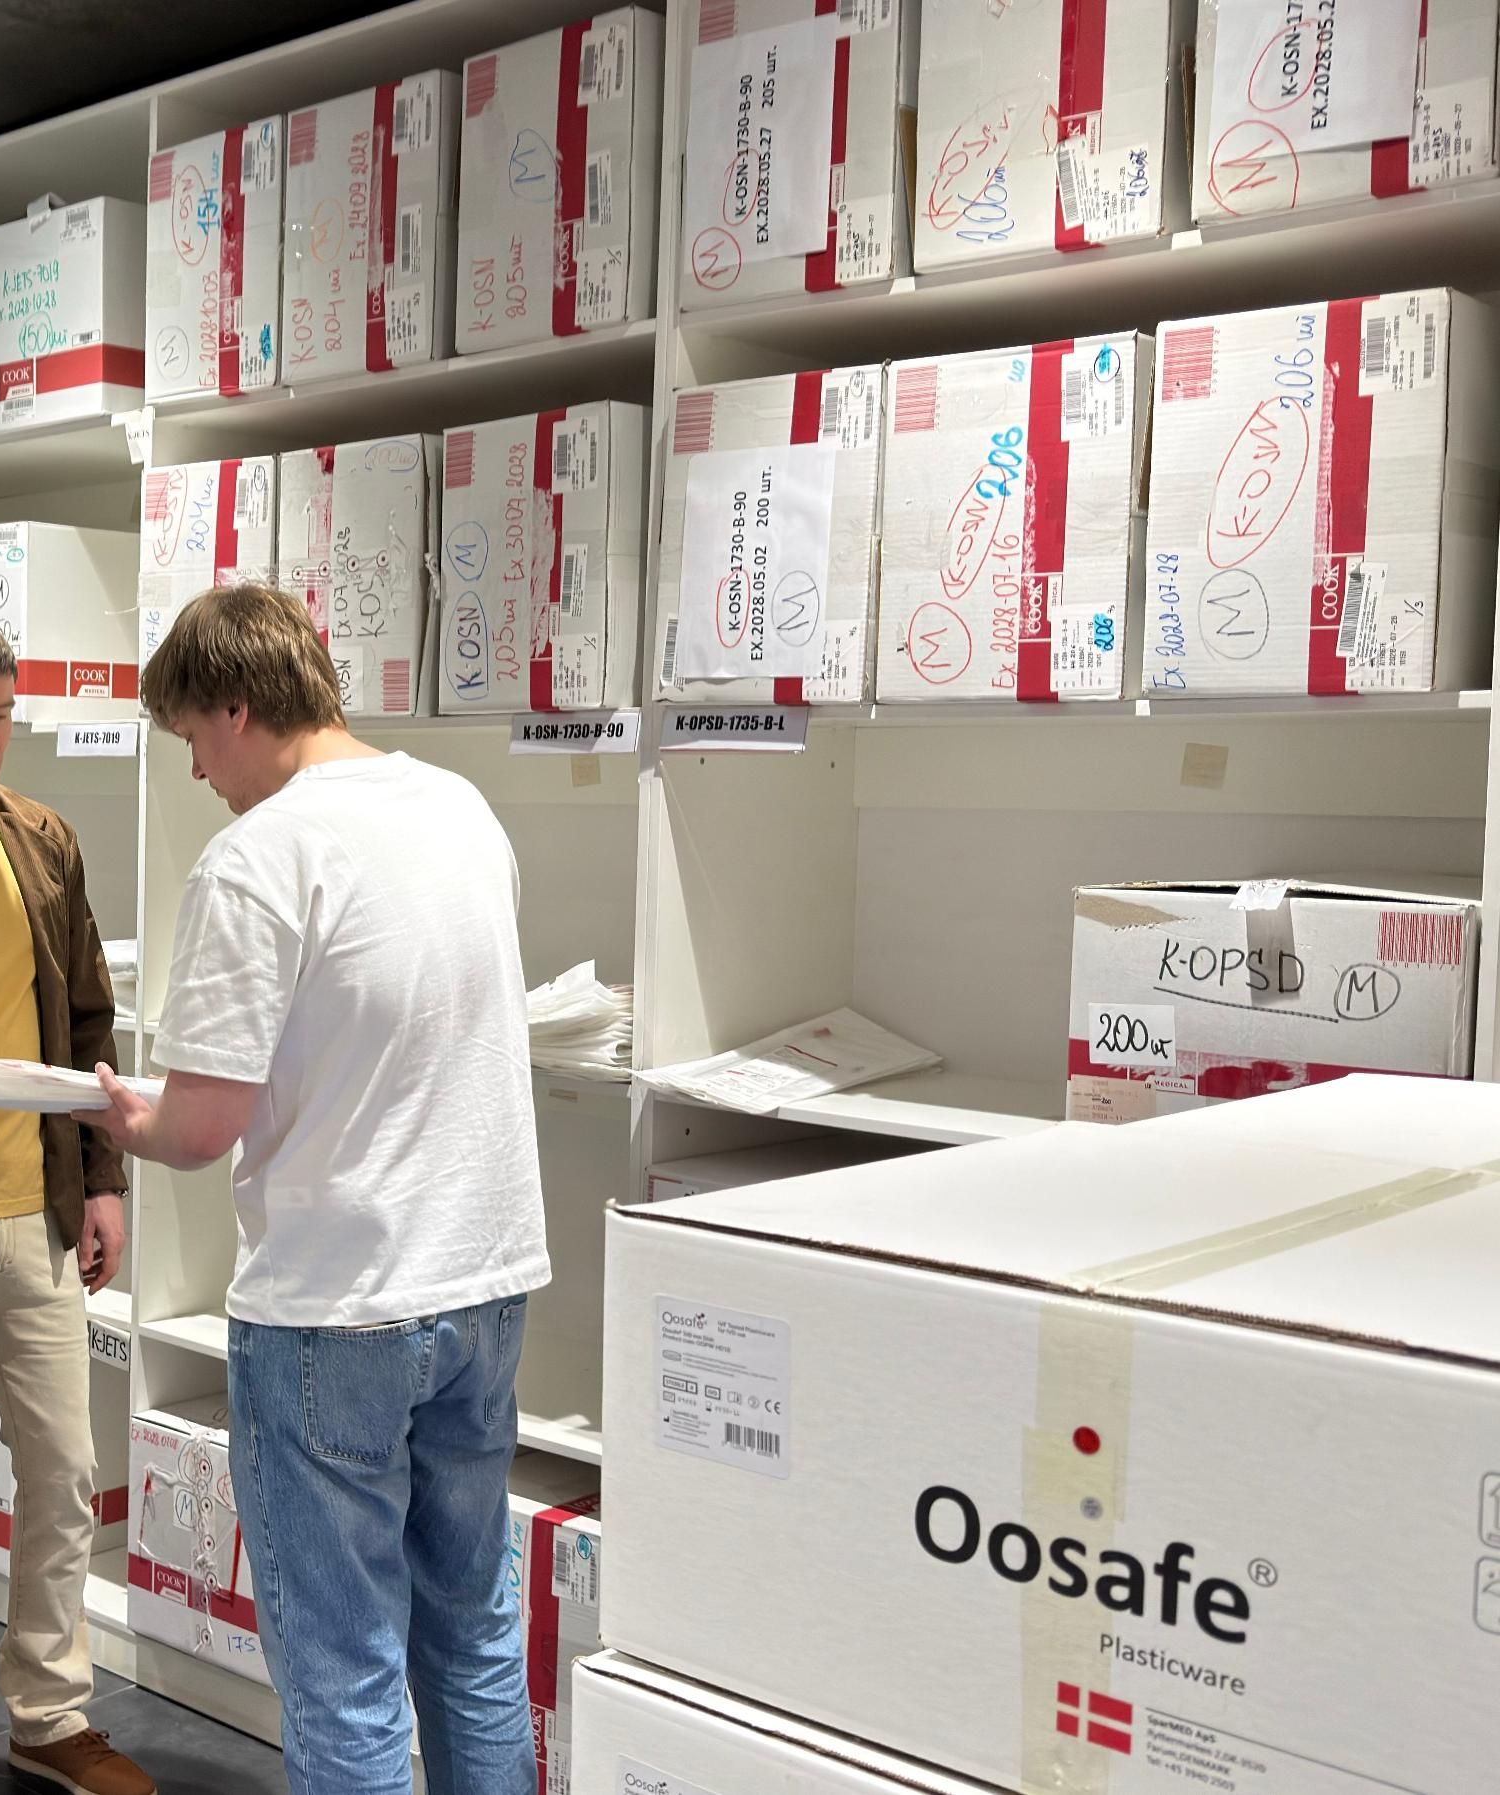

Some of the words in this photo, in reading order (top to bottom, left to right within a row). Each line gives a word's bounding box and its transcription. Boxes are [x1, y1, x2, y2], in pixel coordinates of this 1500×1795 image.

[761, 79, 775, 109] 205
[513, 148, 547, 184] M
[734, 74, 754, 218] K-OSN-1730-B-90
[1219, 138, 1278, 194] M
[756, 127, 773, 245] EX.2028.05.27
[179, 177, 196, 255] K-OSN
[699, 240, 730, 279] M
[468, 257, 497, 332] K-OSN
[289, 298, 317, 364] K-OSN
[2, 367, 30, 383] COOK
[1274, 347, 1314, 410] 206
[758, 464, 773, 494] шт.
[975, 425, 1024, 499] 206
[755, 497, 771, 529] 200
[455, 543, 477, 568] M
[728, 490, 747, 632] K-OSN-1730-B-90
[750, 545, 768, 662] EX.2028.05.02
[989, 533, 1023, 653] 2028-07-16
[1028, 580, 1043, 635] COOK
[1206, 588, 1255, 637] M
[1321, 564, 1340, 620] COOK
[456, 604, 487, 691] K-OSN
[919, 627, 951, 668] M
[1094, 618, 1115, 651] 206
[74, 669, 107, 683] COOK
[74, 731, 120, 744] K-JETS-7019
[523, 722, 625, 741] K-OSN-1730-B-90
[675, 714, 786, 732] K-OPSD-1735-B-L
[1157, 937, 1306, 994] K-OPSD
[1345, 968, 1380, 1014] M
[1153, 1079, 1189, 1090] MEDICAL
[90, 1328, 128, 1363] K-JETS
[179, 1494, 193, 1521] M
[156, 1570, 186, 1590] COOK
[1099, 1632, 1246, 1696] Plasticware
